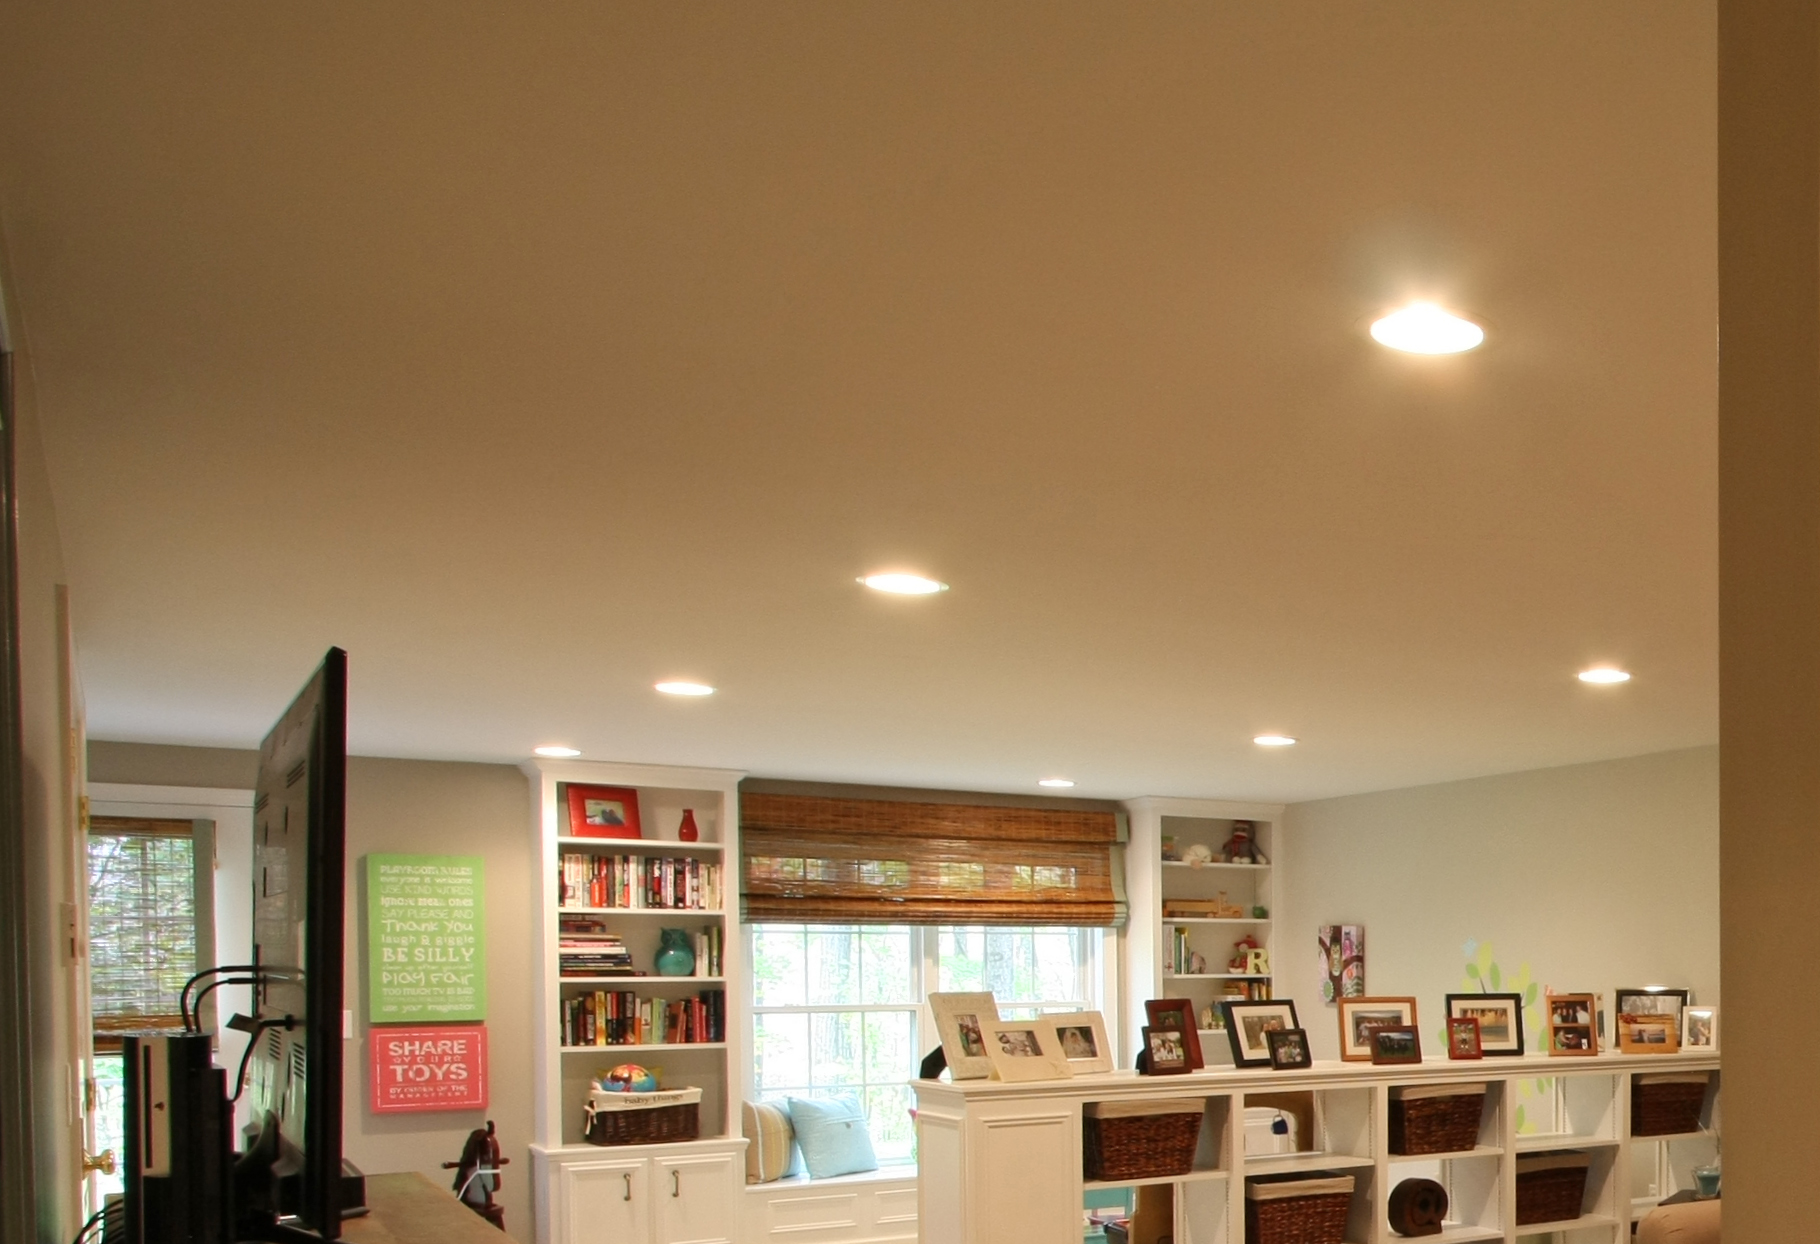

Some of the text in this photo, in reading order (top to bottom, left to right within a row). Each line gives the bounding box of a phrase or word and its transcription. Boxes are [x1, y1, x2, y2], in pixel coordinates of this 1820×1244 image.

[382, 909, 474, 919] SAY PLEASE AND
[381, 934, 416, 946] laugh
[382, 947, 475, 962] BE SILLY
[389, 1039, 467, 1056] SHARE
[389, 1063, 468, 1082] TOYS
